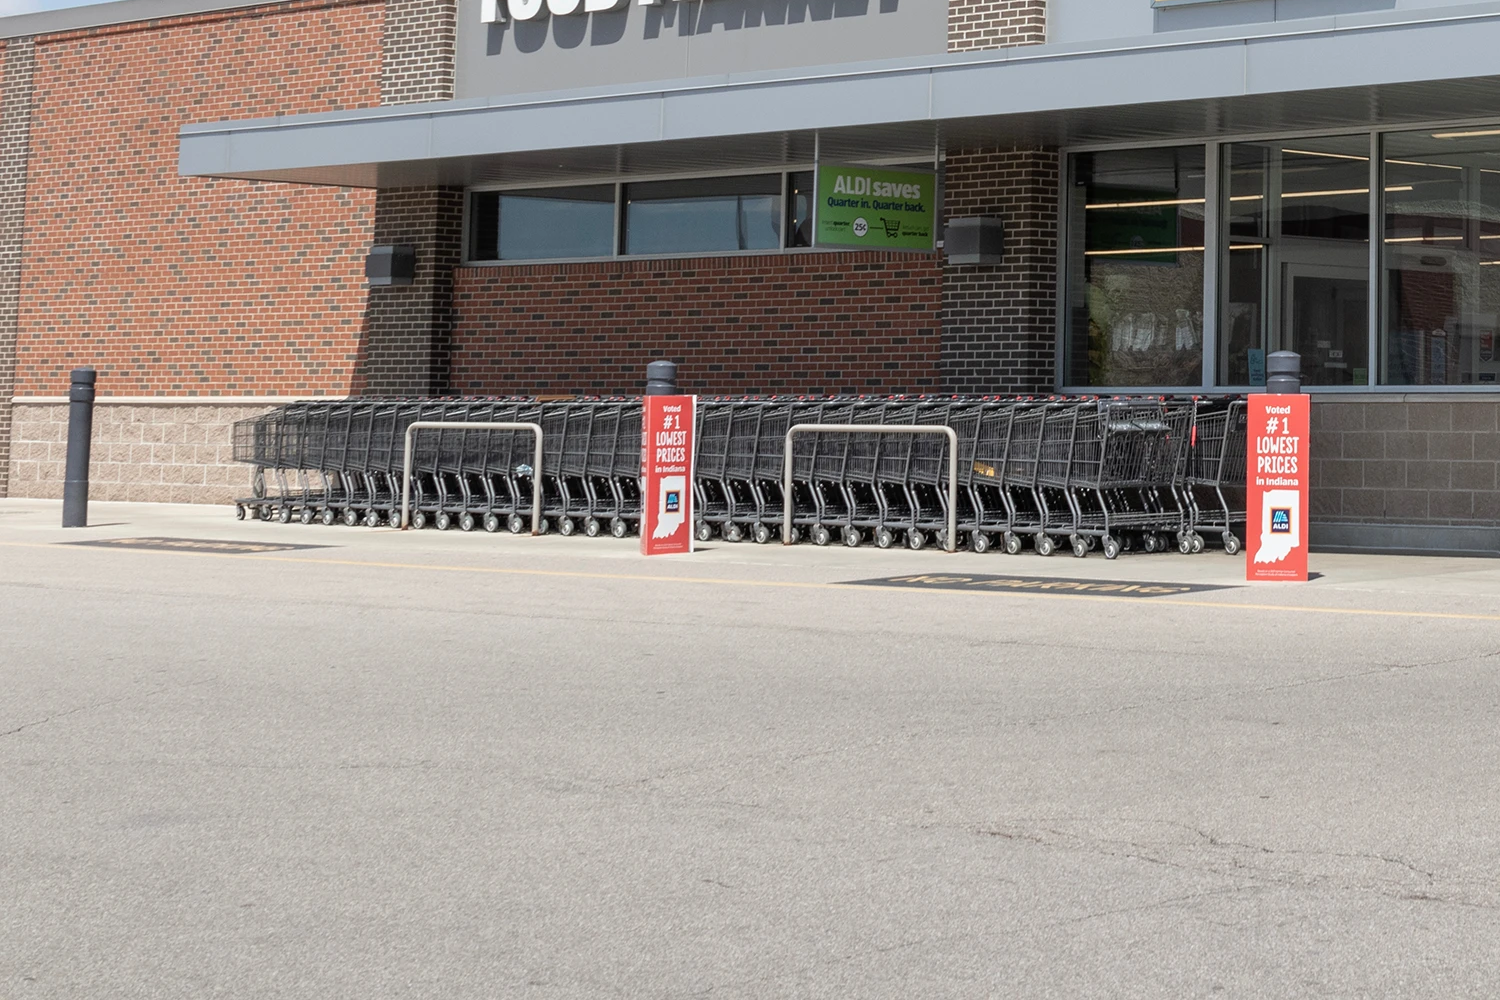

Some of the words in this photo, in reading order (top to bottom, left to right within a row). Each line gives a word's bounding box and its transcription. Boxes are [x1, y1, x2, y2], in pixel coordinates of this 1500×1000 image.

[833, 175, 871, 196] ALDI
[872, 181, 921, 199] saves
[827, 197, 859, 208] Quarter
[861, 198, 871, 209] in.
[872, 200, 903, 211] Quarter
[904, 201, 926, 213] back.
[1265, 405, 1291, 414] Voted
[1266, 417, 1290, 434] #1
[656, 430, 687, 447] LOWEST
[1256, 436, 1300, 454] LOWEST
[656, 447, 686, 463] PRICES
[1257, 455, 1298, 474] PRICES
[1256, 476, 1264, 486] in
[1266, 476, 1299, 486] Indiana
